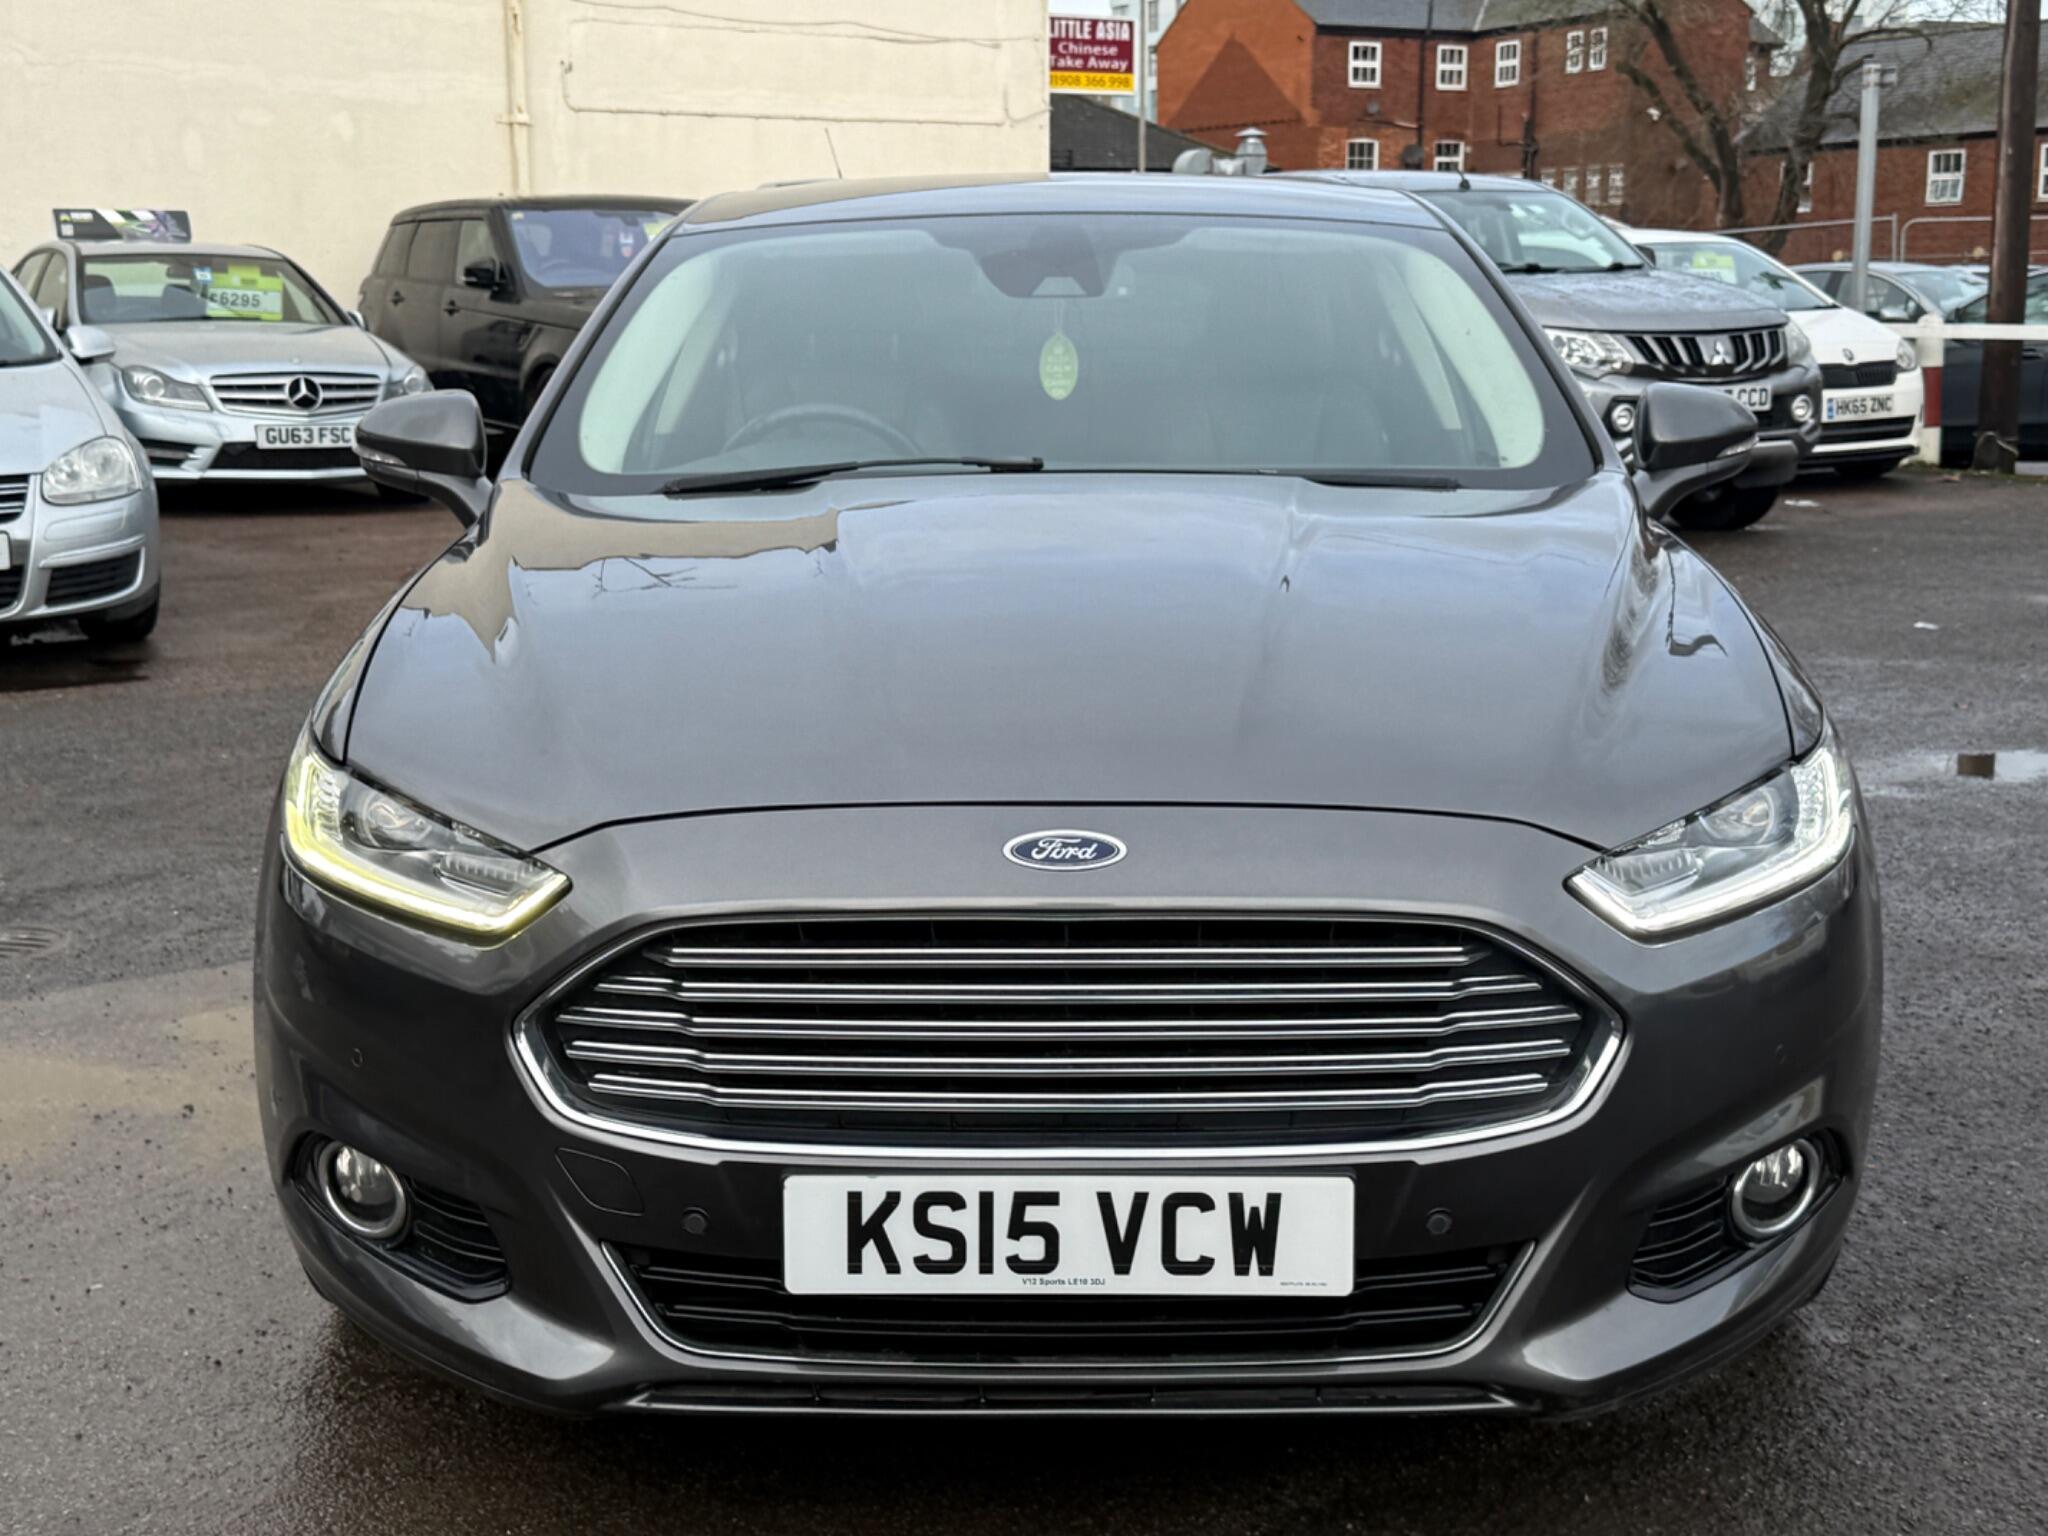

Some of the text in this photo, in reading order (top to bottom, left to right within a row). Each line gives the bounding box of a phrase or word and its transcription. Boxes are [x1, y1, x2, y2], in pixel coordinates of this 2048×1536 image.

[1096, 21, 1130, 41] ASIA
[1057, 41, 1118, 56] Chinese
[1050, 55, 1129, 72] Take Away
[1737, 388, 1769, 407] CCD
[1836, 399, 1867, 416] HK65
[1870, 397, 1892, 414] ZNC
[266, 427, 351, 445] GU63 FSC
[1031, 837, 1099, 860] Ford
[847, 1190, 1283, 1277] KS15 VCW
[1022, 1278, 1037, 1286] V12
[1039, 1278, 1066, 1287] Sports
